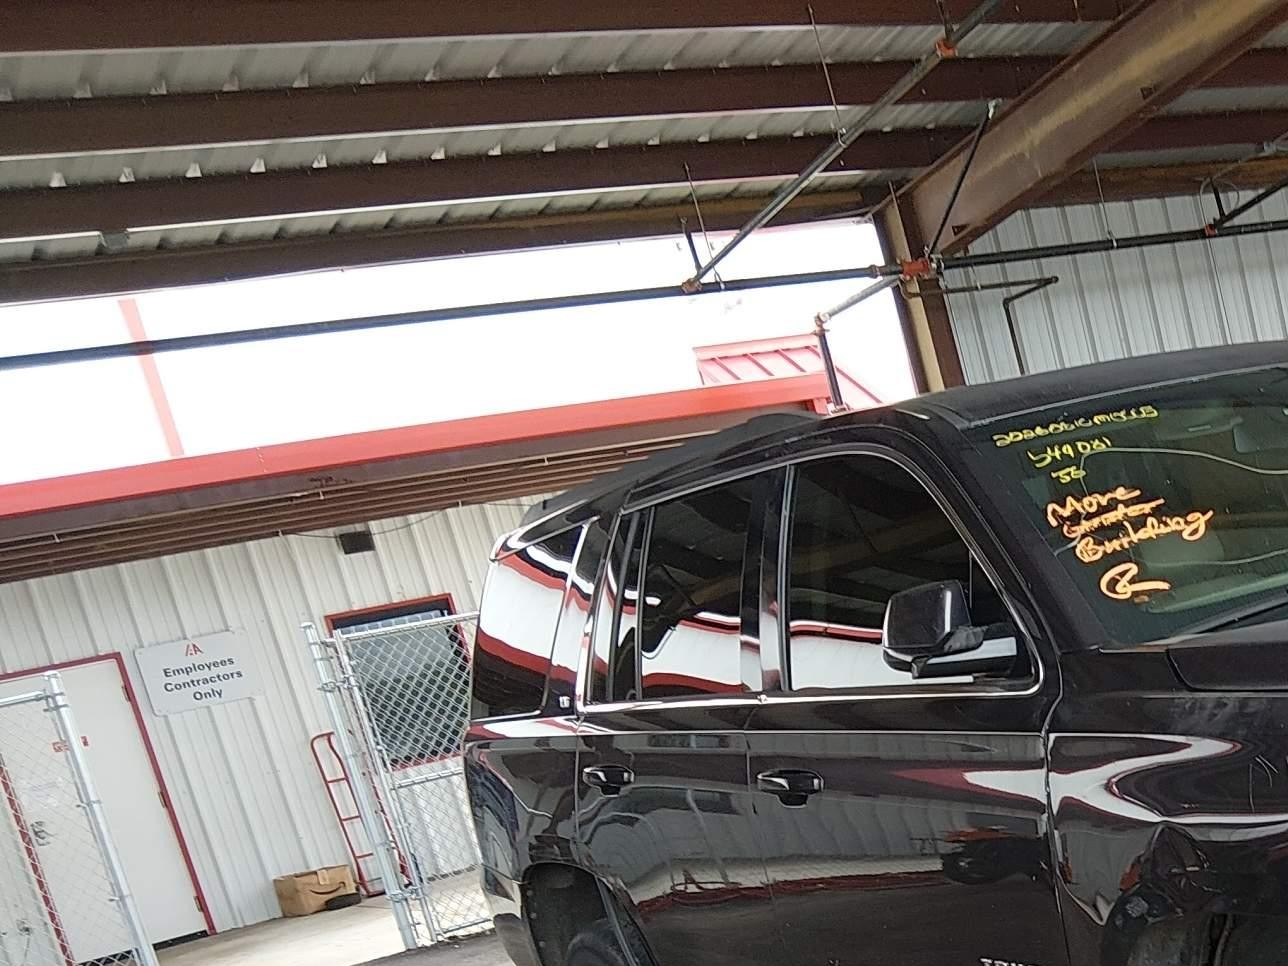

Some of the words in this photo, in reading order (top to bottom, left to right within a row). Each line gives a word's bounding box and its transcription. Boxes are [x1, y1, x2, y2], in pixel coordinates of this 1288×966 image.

[162, 657, 235, 678] Employees
[163, 669, 243, 693] Contractors
[192, 687, 223, 702] Only
